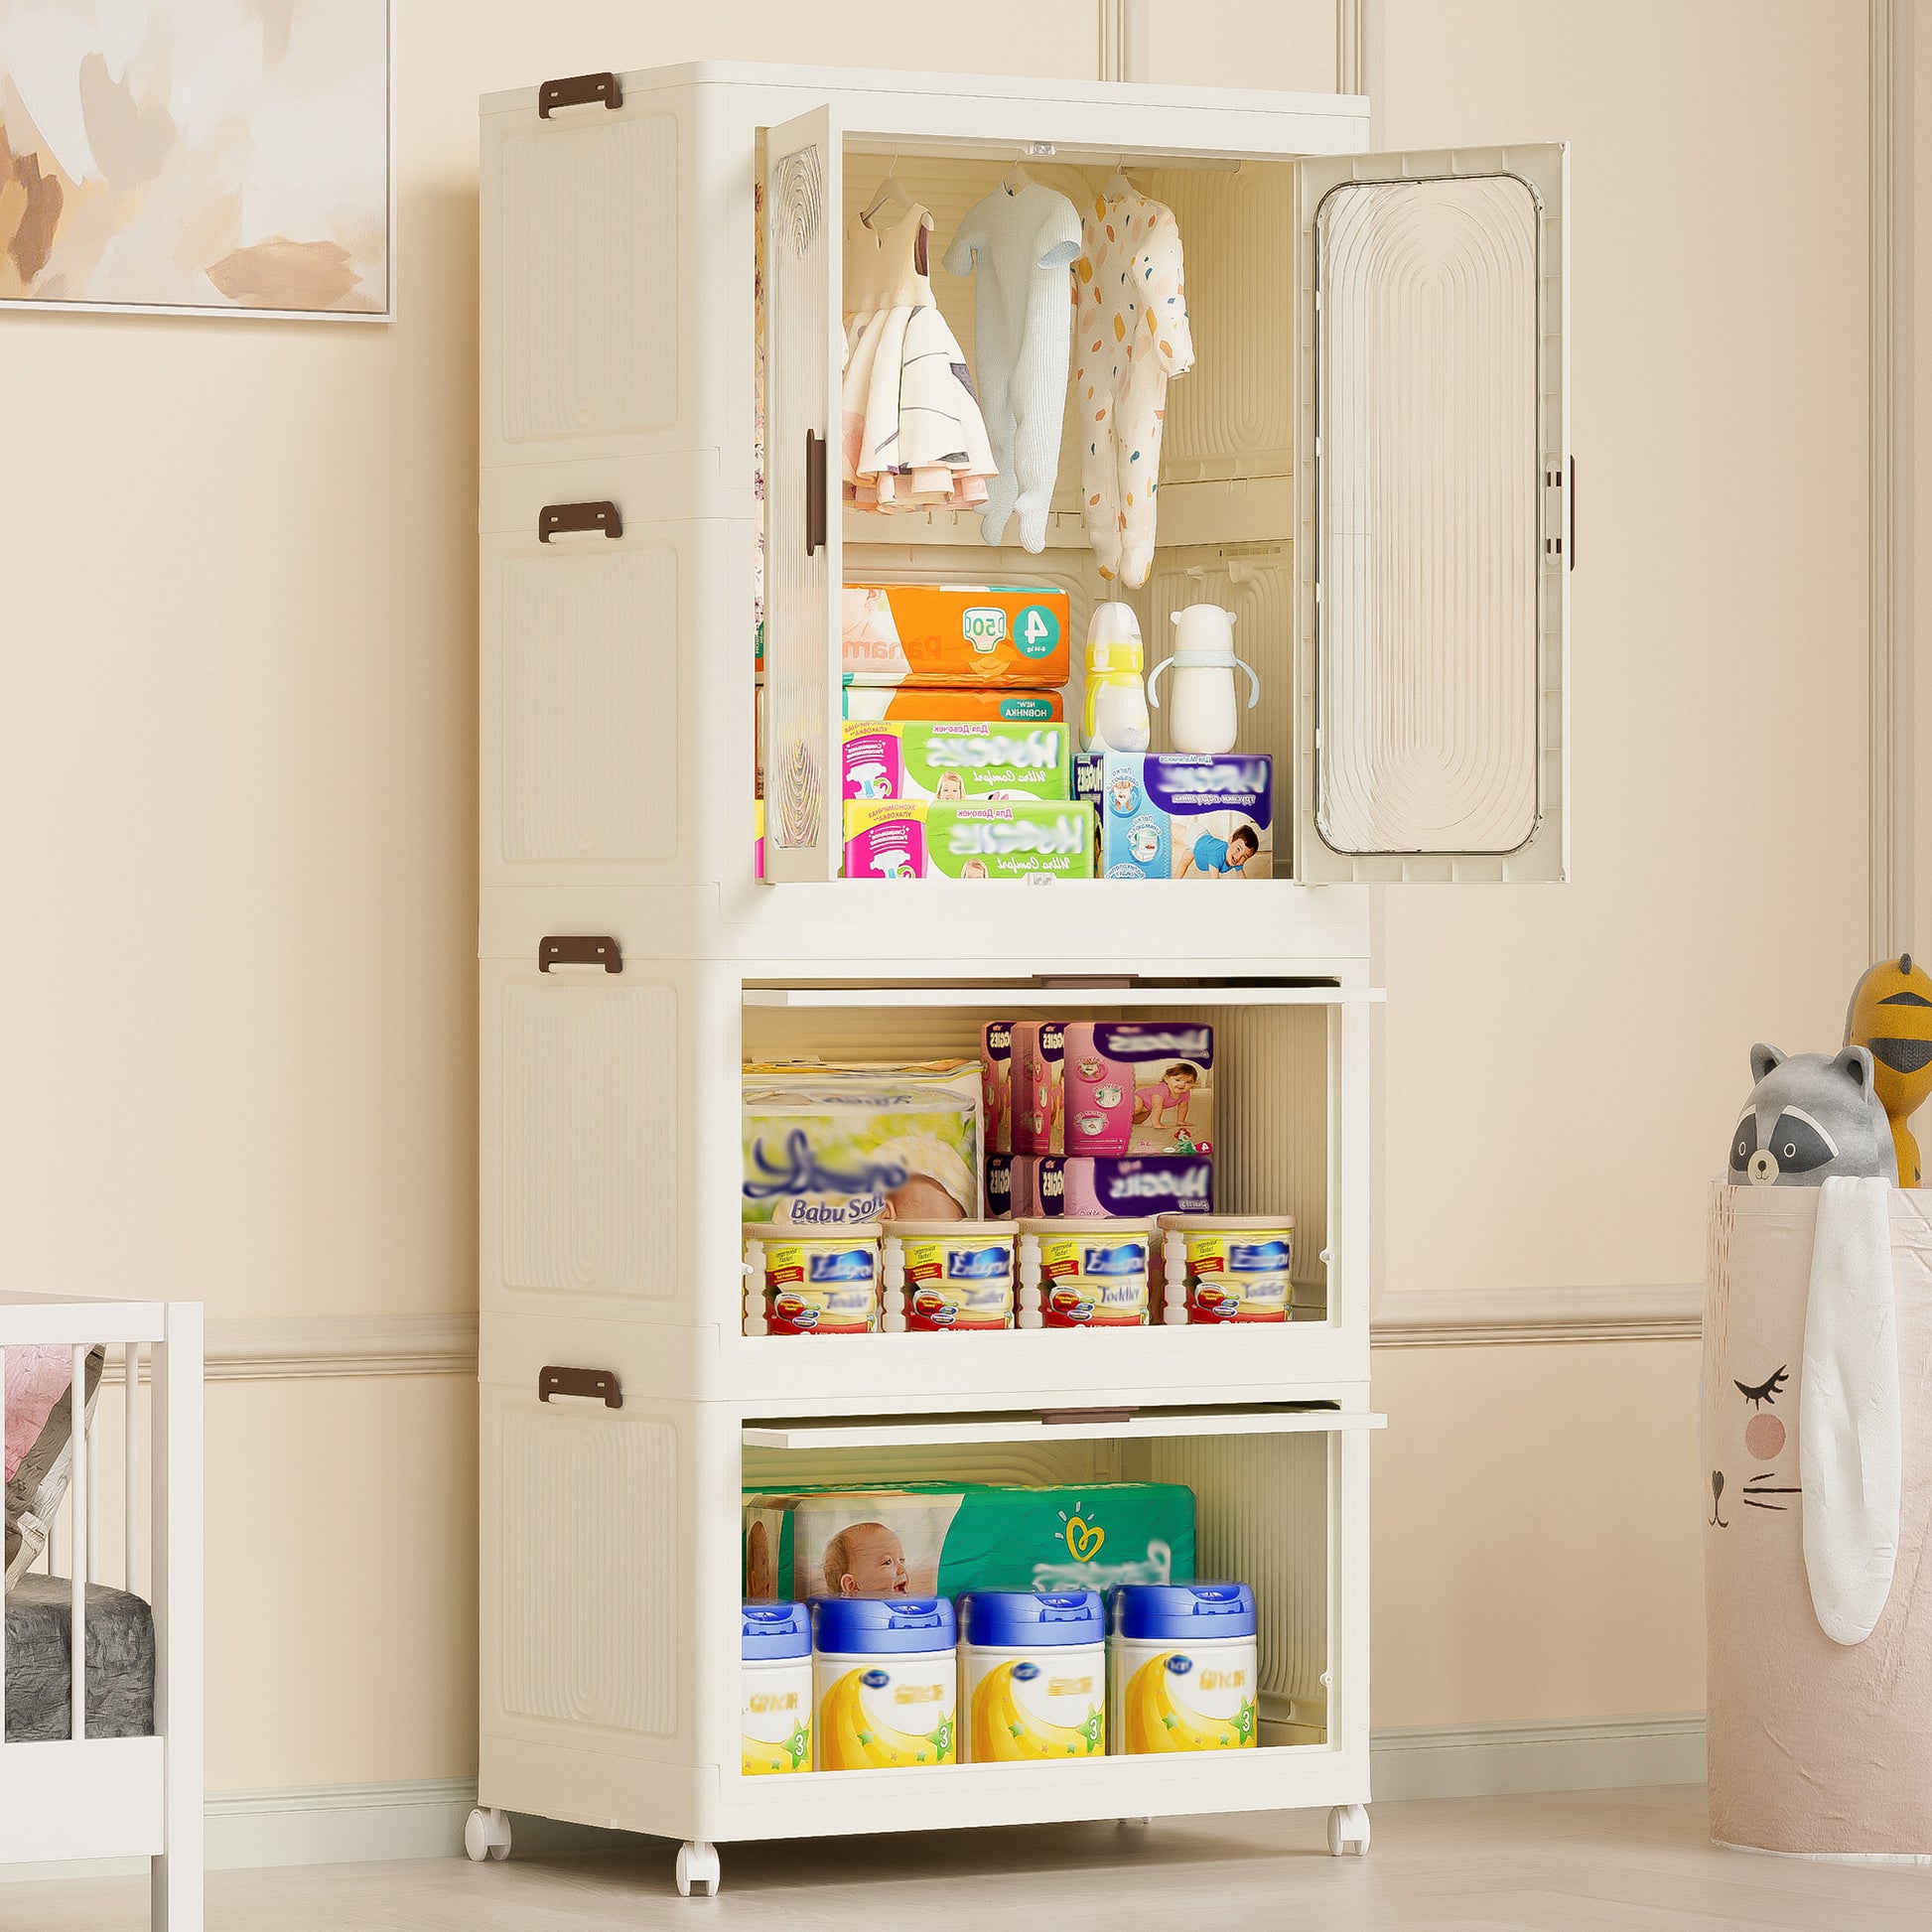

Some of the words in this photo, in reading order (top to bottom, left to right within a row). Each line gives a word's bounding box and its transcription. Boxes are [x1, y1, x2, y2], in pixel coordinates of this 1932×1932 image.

[848, 1193, 886, 1219] Soft
[1089, 1719, 1098, 1739] 3
[1242, 1711, 1251, 1731] 3
[795, 1733, 804, 1756] 3
[939, 1726, 949, 1747] 3
